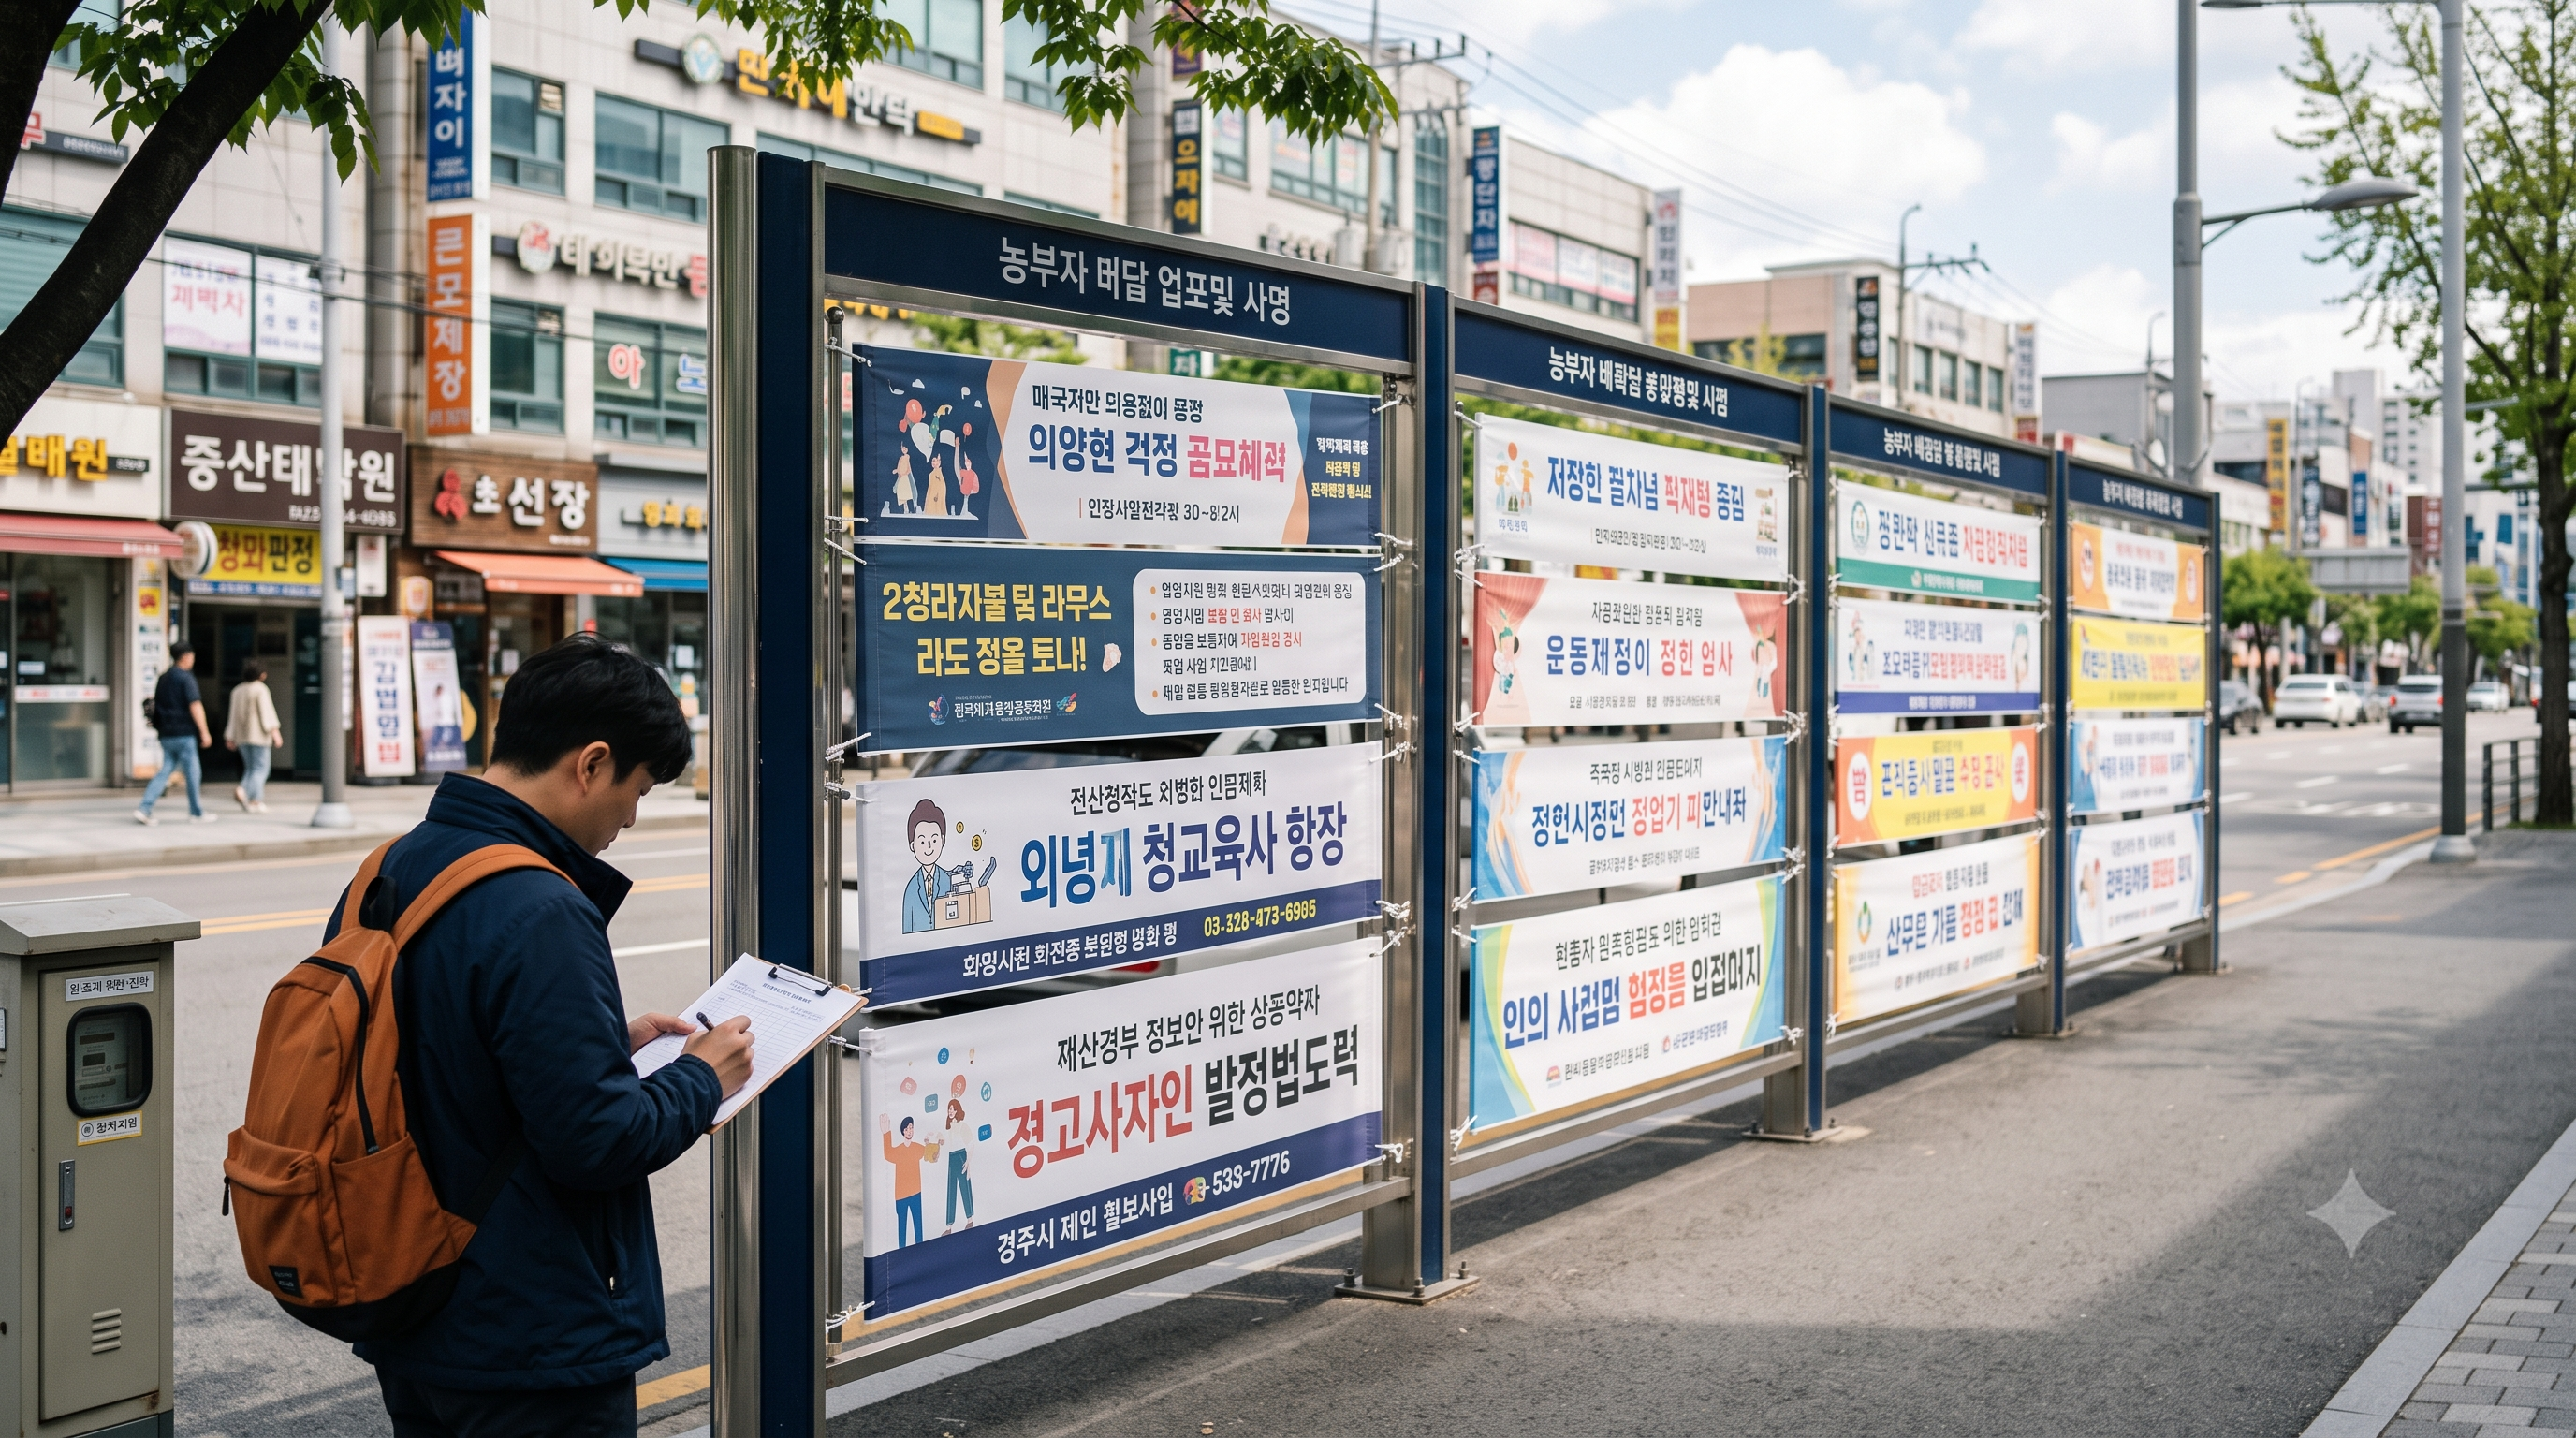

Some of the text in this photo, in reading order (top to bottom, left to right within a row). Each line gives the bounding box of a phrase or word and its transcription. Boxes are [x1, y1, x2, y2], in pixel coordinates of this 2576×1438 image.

[998, 236, 1090, 295] 농부자
[1242, 280, 1291, 327] 사명
[1548, 345, 1597, 389] 농부자
[1041, 583, 1113, 623] 라무스
[916, 637, 972, 678] 라도
[1142, 809, 1279, 894] 청교육사
[1285, 800, 1349, 873] 항장
[1056, 1021, 1140, 1073] 재산경부
[1145, 1007, 1205, 1055] 정보안
[1208, 998, 1246, 1040] 위한
[1502, 991, 1550, 1050] 인의
[996, 1216, 1056, 1265] 경주시
[1060, 1204, 1098, 1243] 제인
